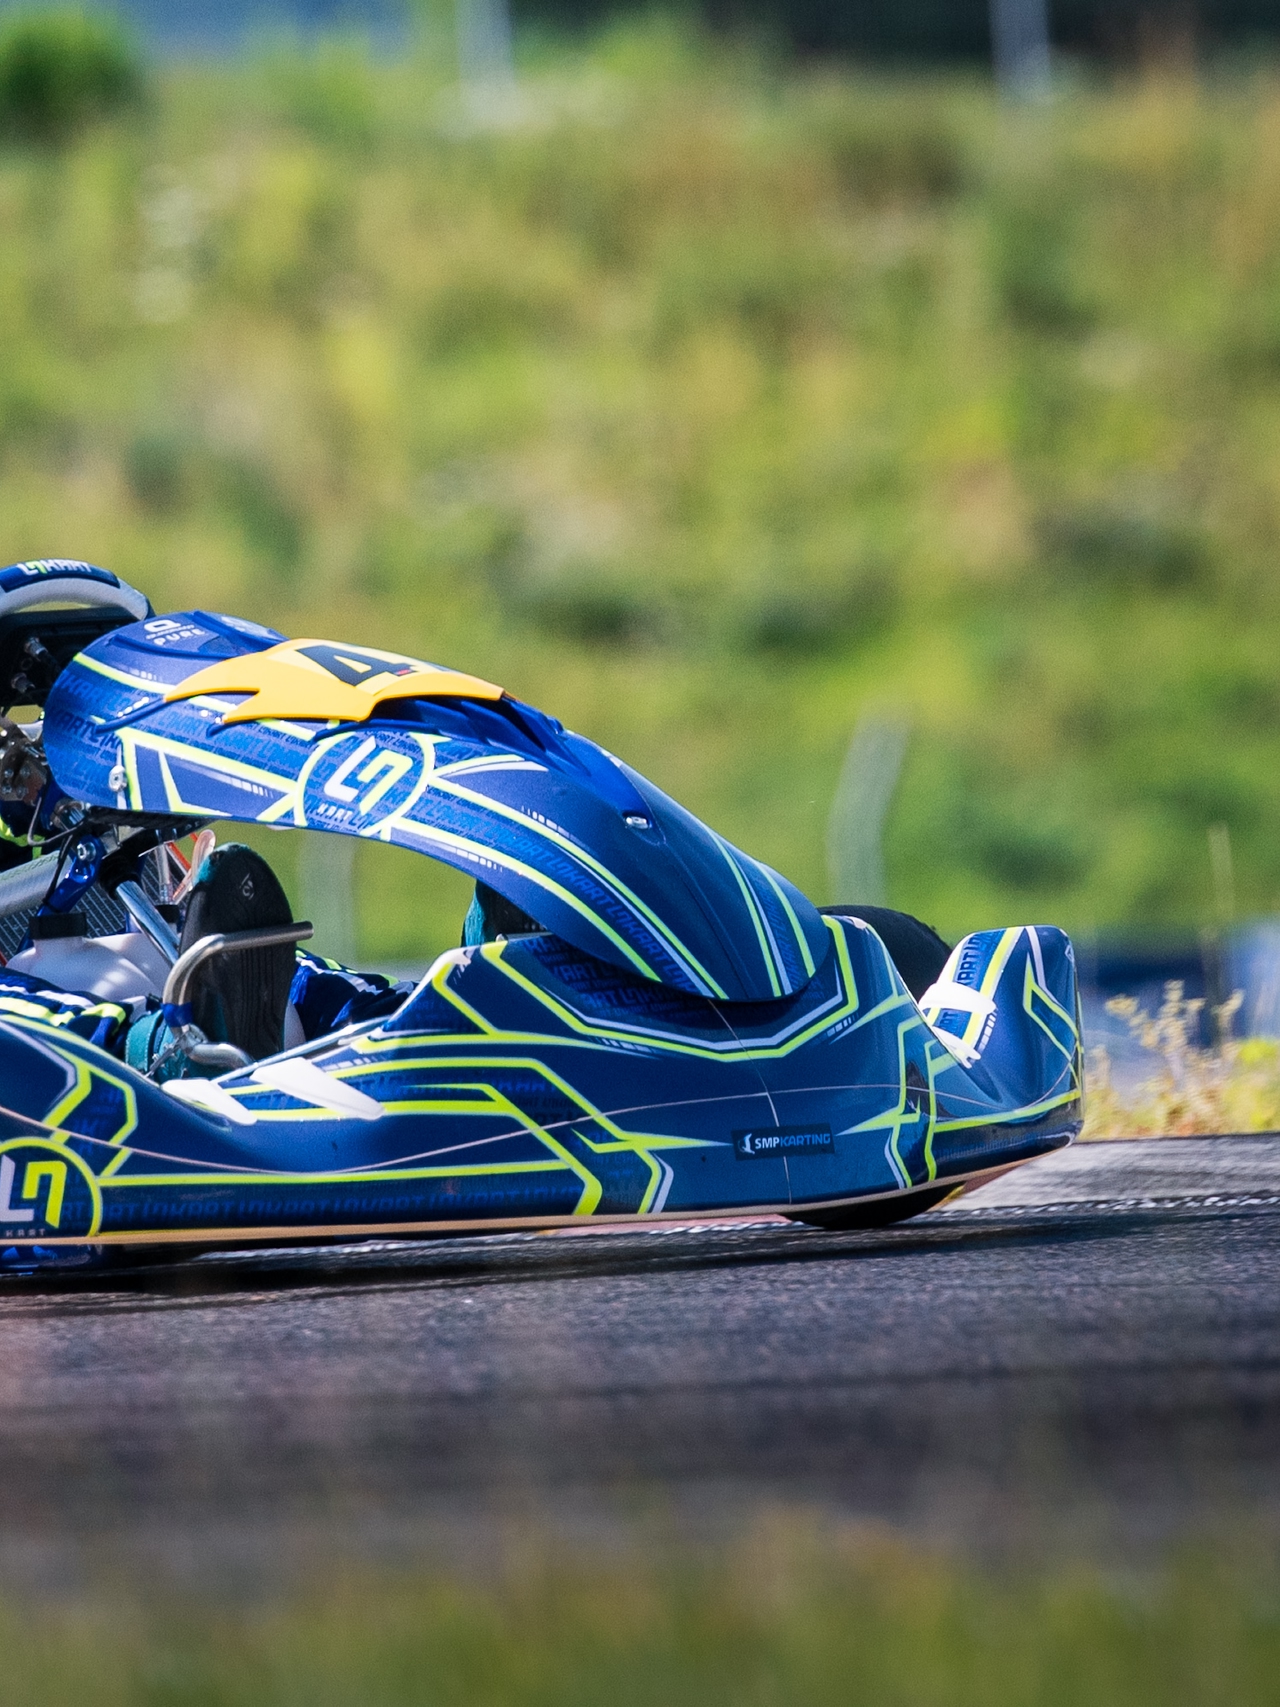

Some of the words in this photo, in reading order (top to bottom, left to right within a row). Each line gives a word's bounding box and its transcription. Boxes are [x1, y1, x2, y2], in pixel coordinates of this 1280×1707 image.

[153, 628, 205, 646] PURE
[317, 803, 353, 822] KART
[754, 1133, 831, 1149] SMPKARTING
[5, 1228, 47, 1237] KART
